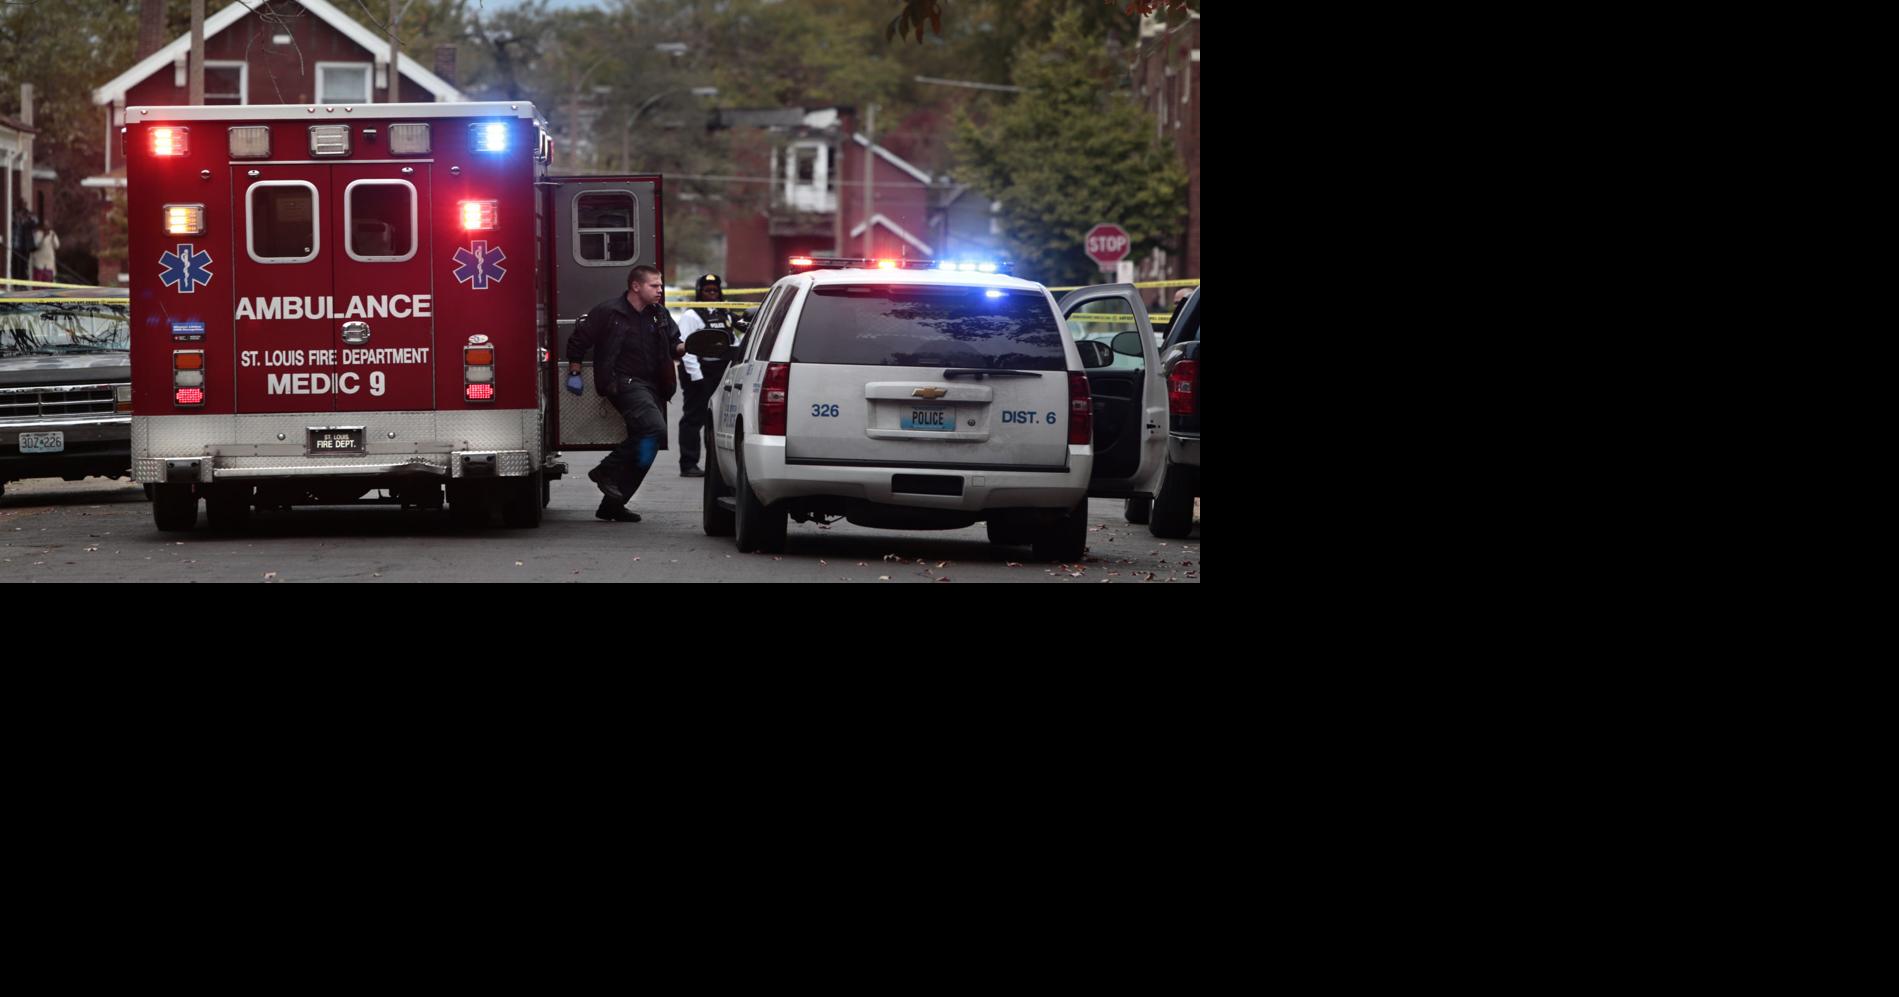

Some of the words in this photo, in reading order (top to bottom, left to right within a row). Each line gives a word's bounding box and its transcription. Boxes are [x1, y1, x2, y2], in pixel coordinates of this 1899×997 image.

[1089, 235, 1127, 252] STOP
[235, 294, 432, 320] AMBULANCE
[241, 350, 261, 367] ST.
[265, 350, 304, 366] LOUIS
[309, 349, 337, 366] FIRE
[342, 348, 429, 365] DEPARTMENT
[267, 372, 360, 395] MEDIC
[369, 371, 386, 396] 9
[811, 404, 839, 417] 326
[912, 411, 944, 425] POLICE
[1002, 411, 1040, 424] DIST.
[1046, 411, 1057, 424] 6
[316, 440, 333, 448] FIRE
[335, 439, 357, 448] DEPT.
